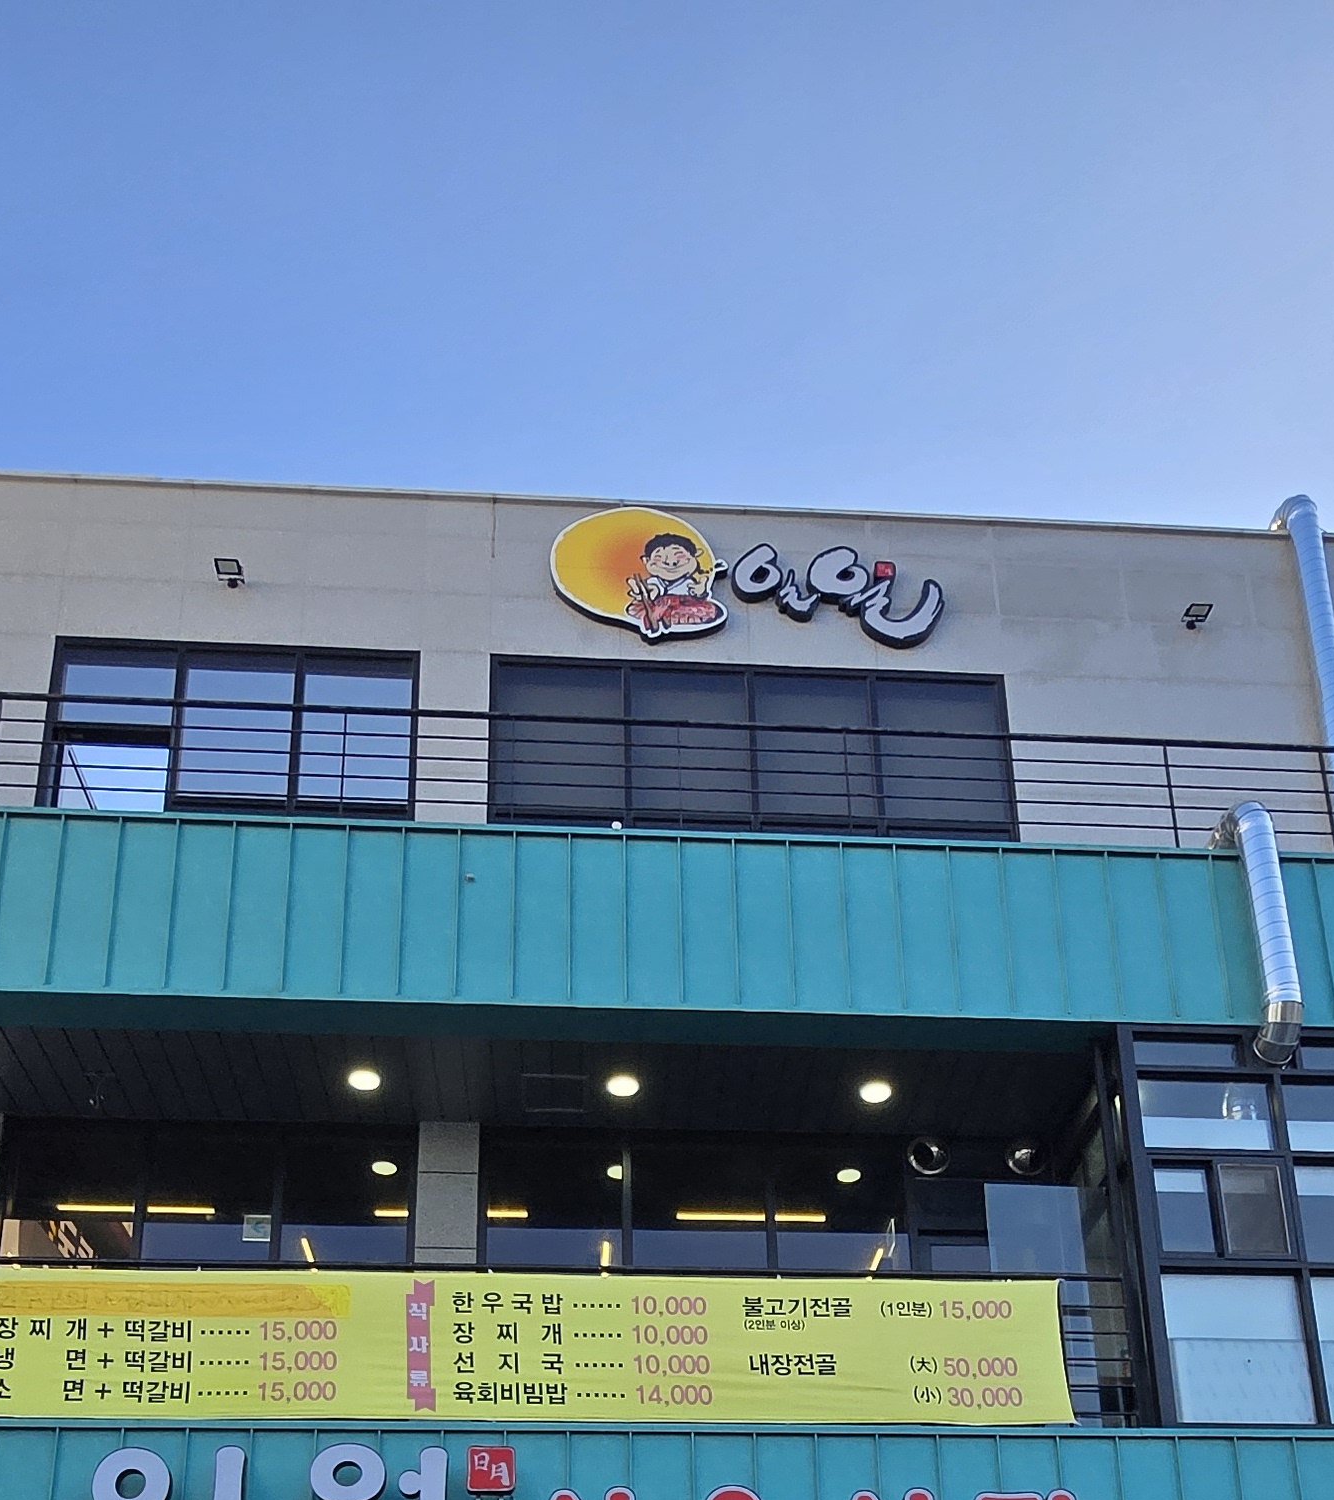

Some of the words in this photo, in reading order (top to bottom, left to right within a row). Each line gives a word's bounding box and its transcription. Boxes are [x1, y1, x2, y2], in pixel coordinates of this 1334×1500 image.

[631, 1296, 707, 1317] 10,000
[742, 1297, 852, 1318] 불고기전골
[880, 1301, 933, 1318] (1인분)
[939, 1300, 1012, 1321] 15,000
[259, 1320, 338, 1342] 15,000
[632, 1325, 708, 1347] 10,000
[259, 1350, 338, 1373] 15,000
[633, 1354, 710, 1376] 10,000
[749, 1353, 837, 1376] 내장전골
[943, 1357, 1018, 1379] 50,000
[258, 1381, 337, 1403] 15,000
[453, 1381, 567, 1405] 육회비빔밥
[636, 1384, 712, 1407] 14,000
[947, 1387, 1023, 1409] 30,000
